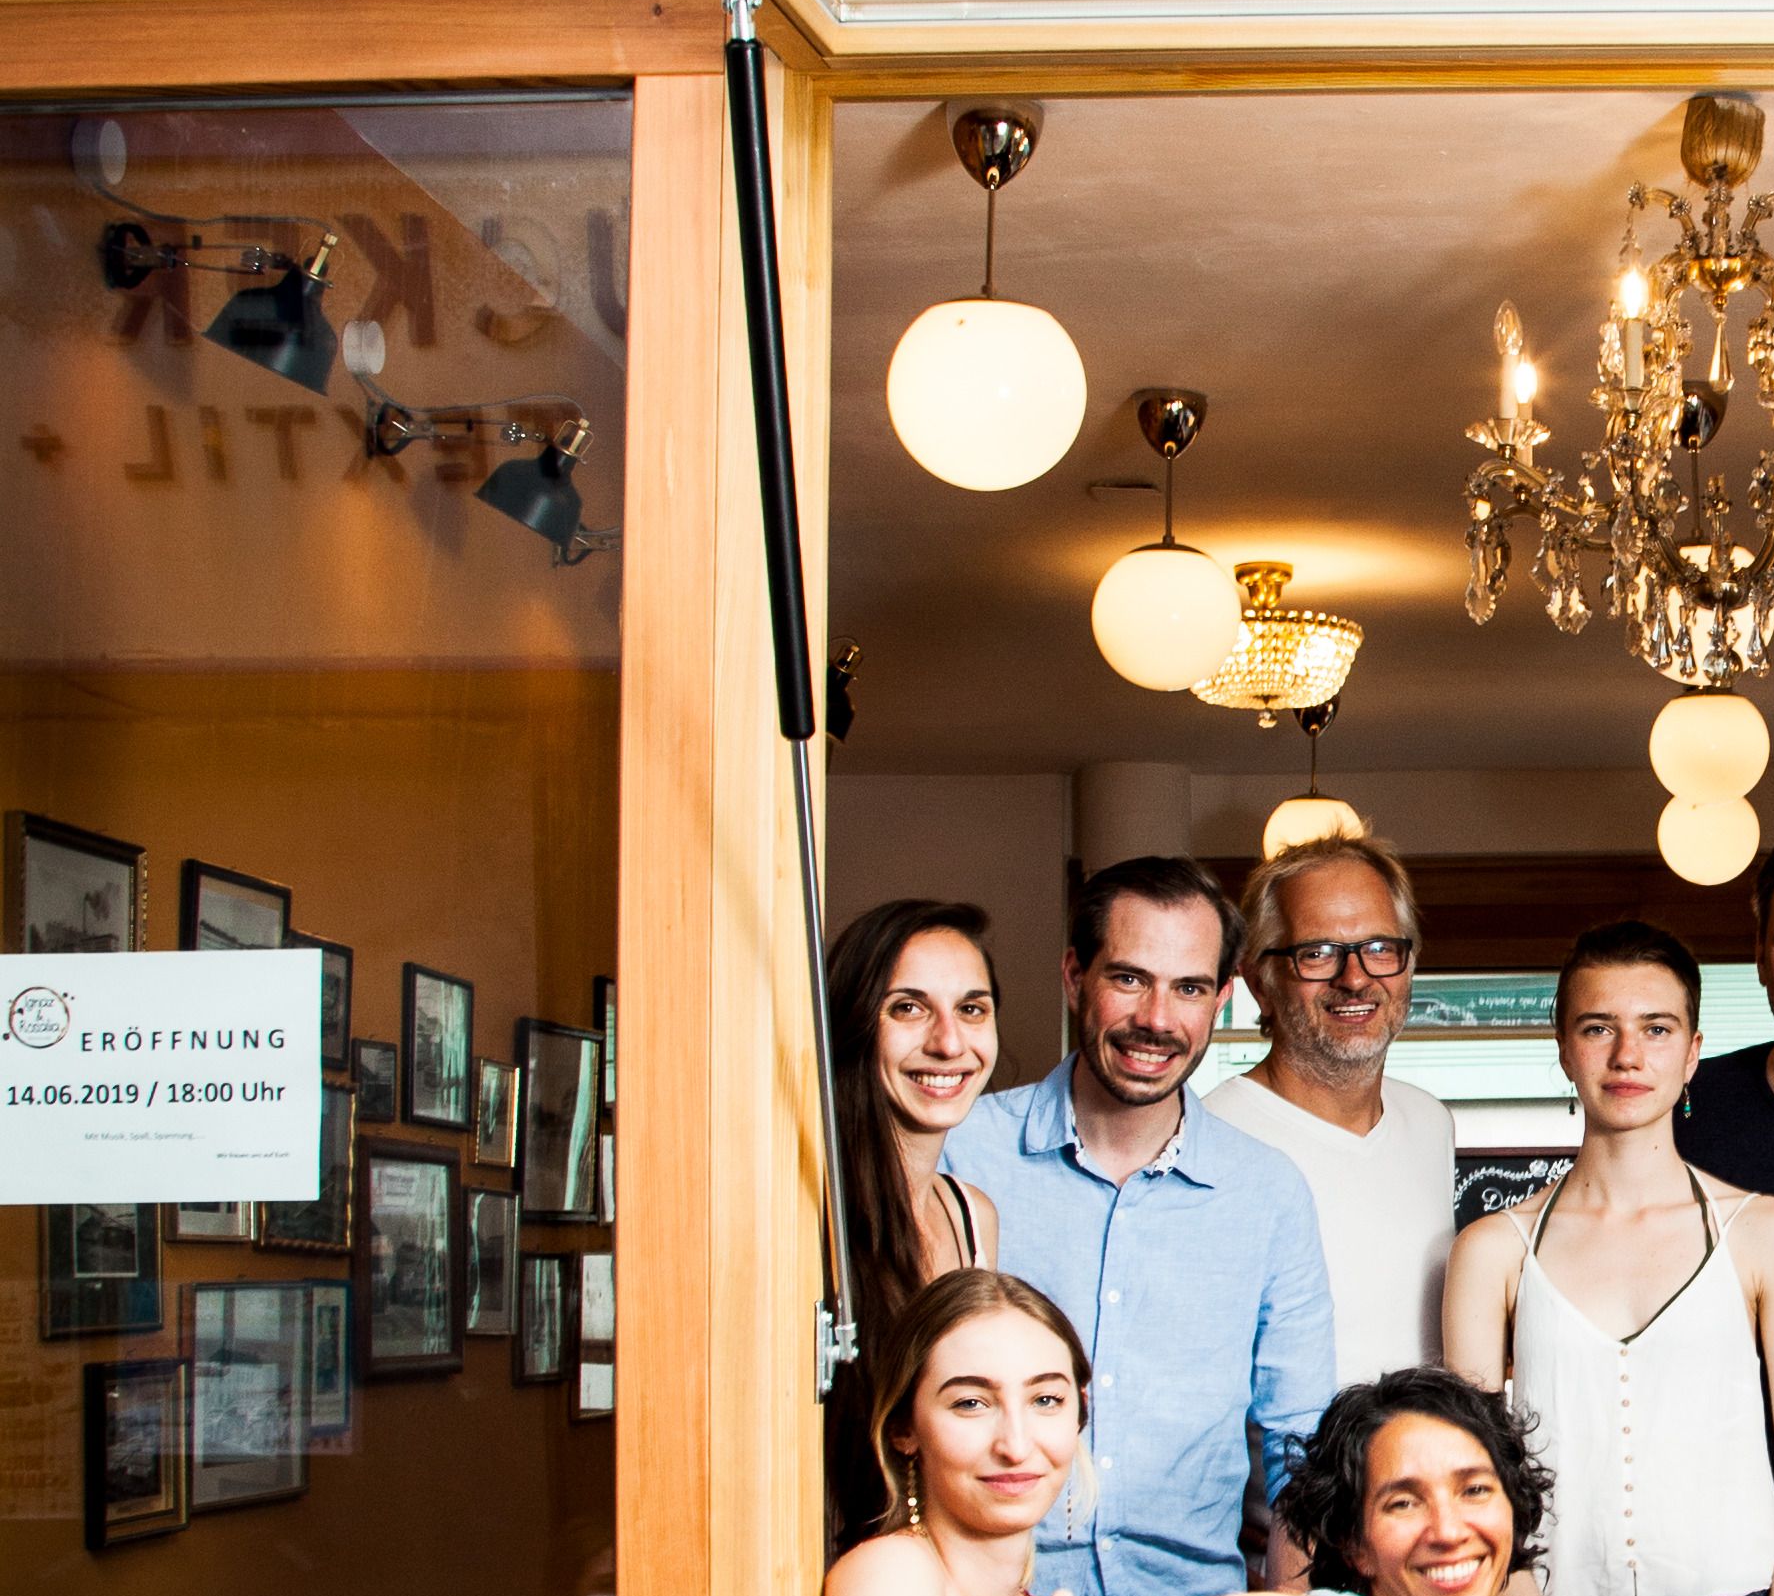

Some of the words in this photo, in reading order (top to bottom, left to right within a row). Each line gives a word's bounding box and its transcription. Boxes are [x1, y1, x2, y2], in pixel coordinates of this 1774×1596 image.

[81, 1026, 286, 1052] ERÖFFNUNG
[7, 1083, 139, 1106] 14.06.2019
[146, 1081, 159, 1108] /
[167, 1082, 234, 1104] 18:00
[242, 1081, 286, 1102] Uhr
